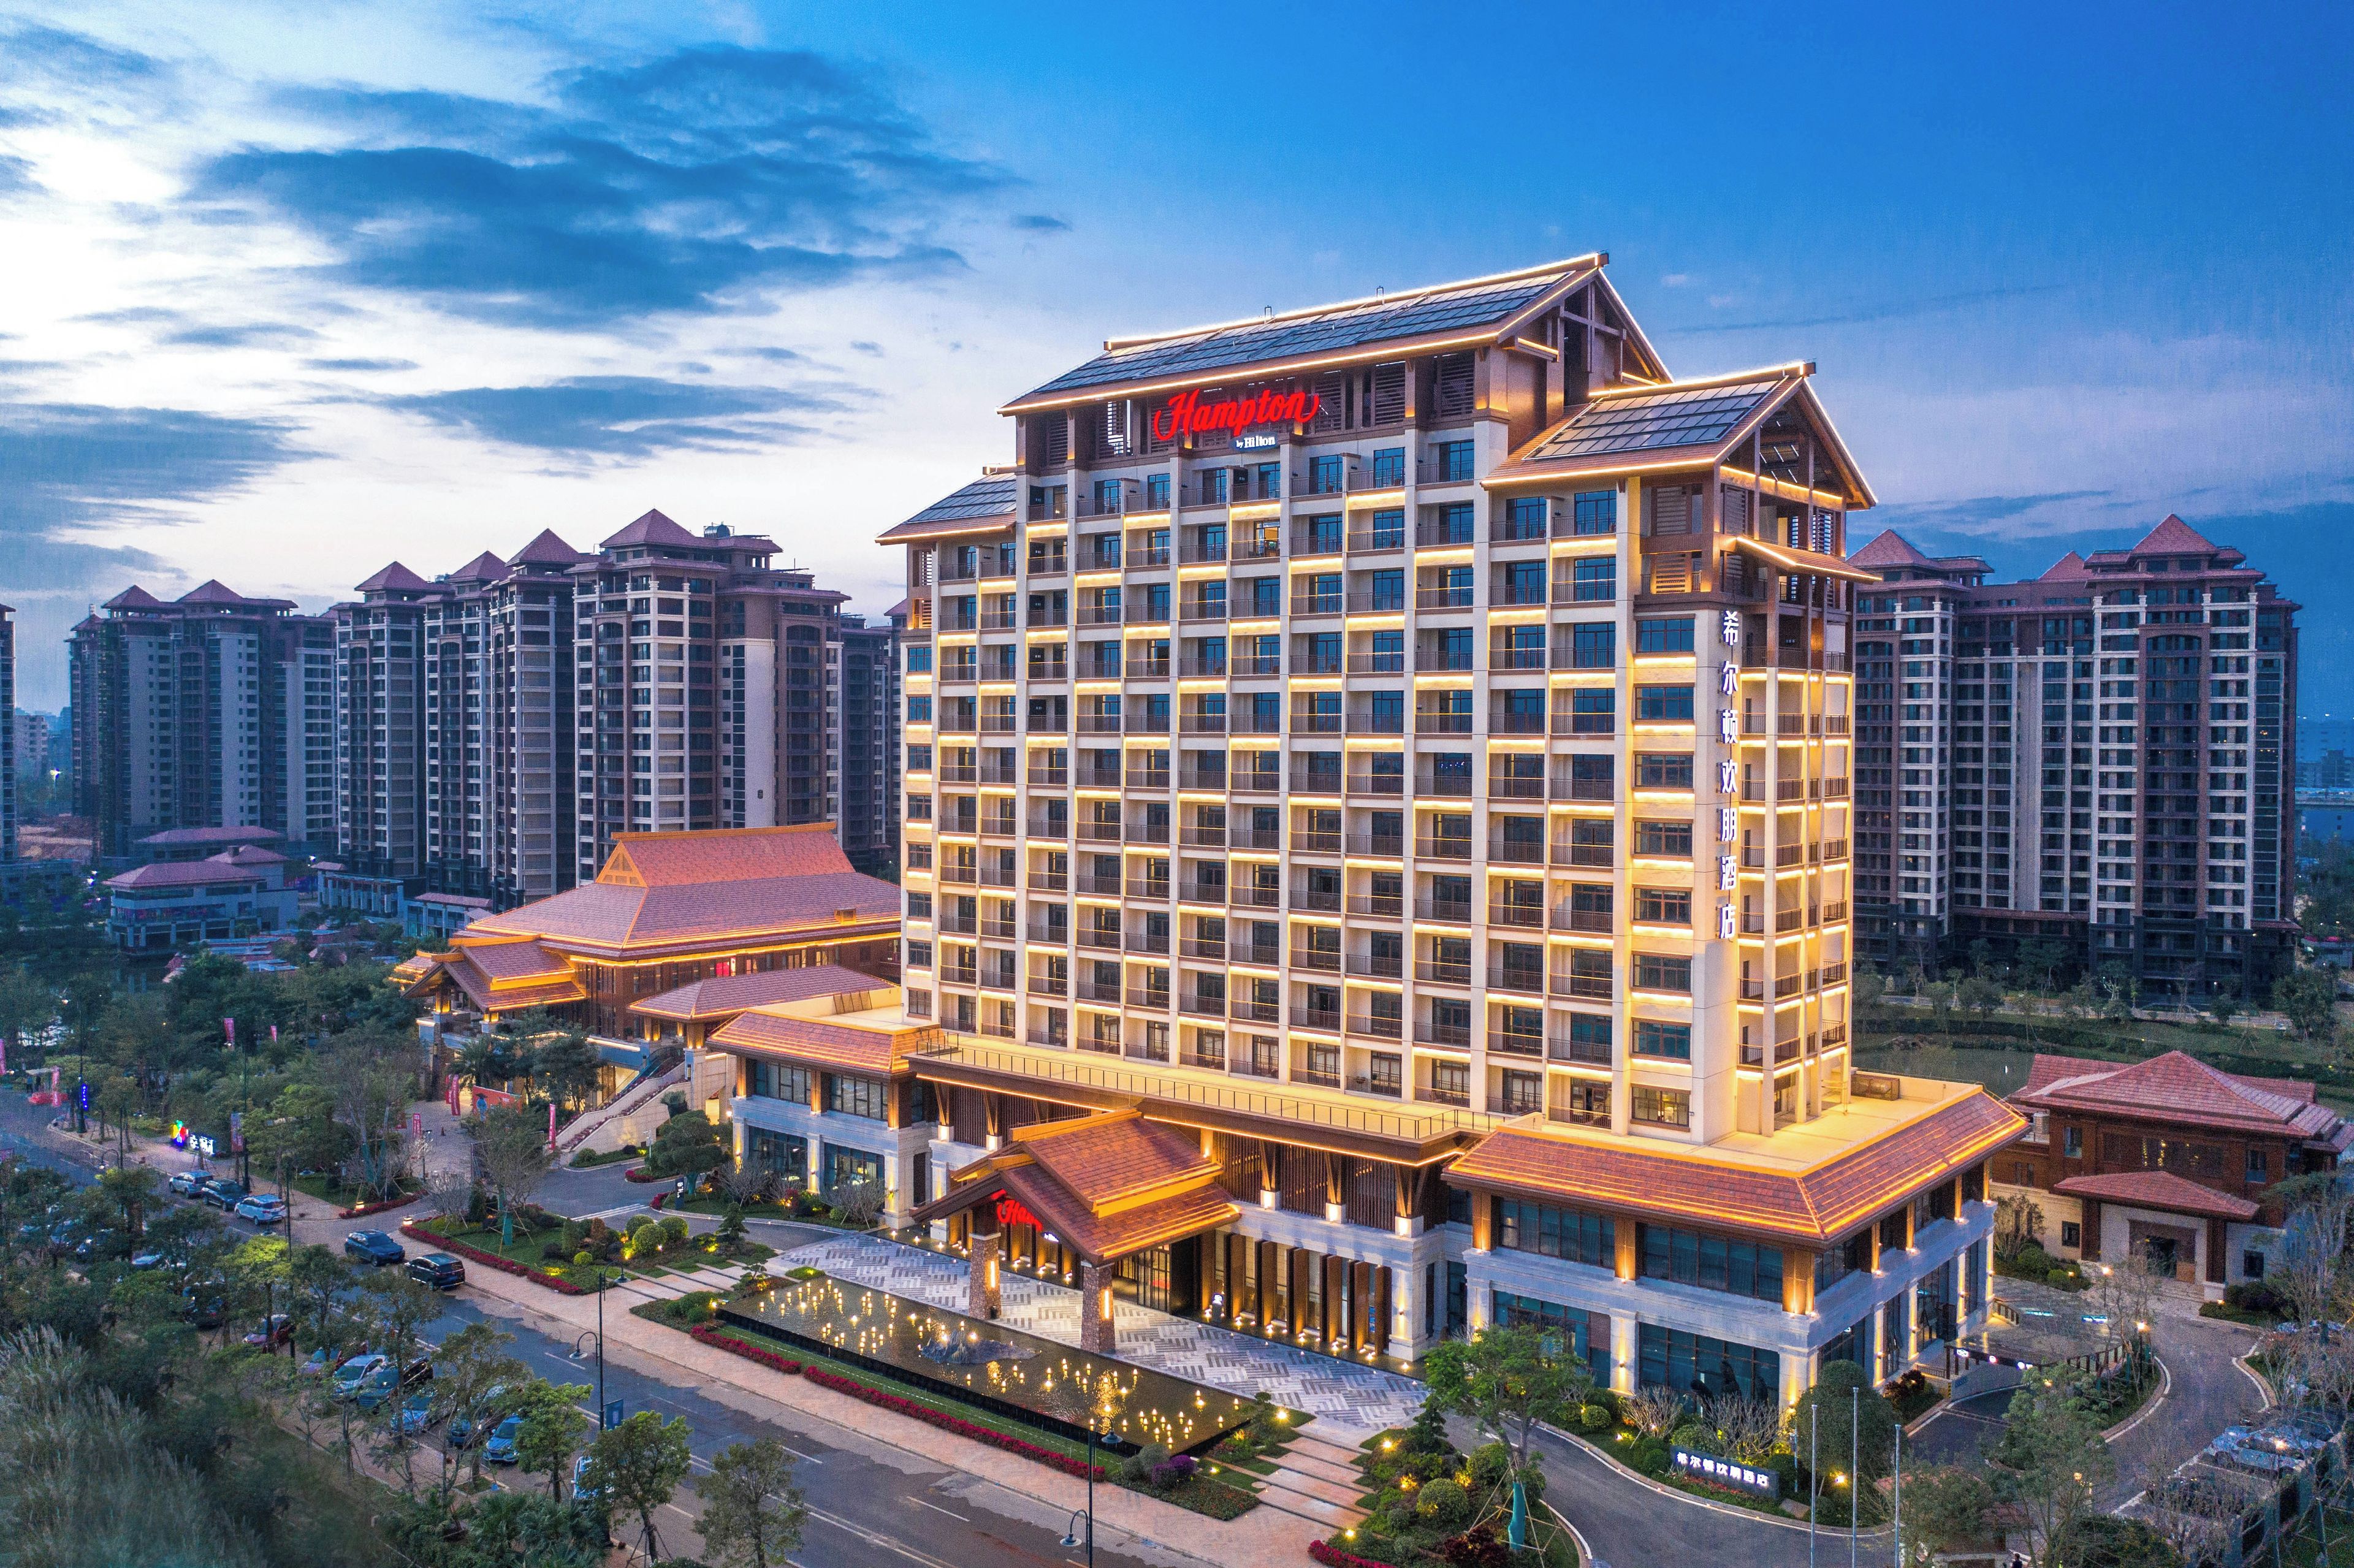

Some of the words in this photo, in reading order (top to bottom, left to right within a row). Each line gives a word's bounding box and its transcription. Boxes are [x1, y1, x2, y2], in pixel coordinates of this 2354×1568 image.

[1154, 389, 1319, 440] Hampton
[1236, 440, 1244, 448] by
[1244, 435, 1276, 448] Hilton
[1721, 609, 1739, 938] 希尔顿欢朋酒店
